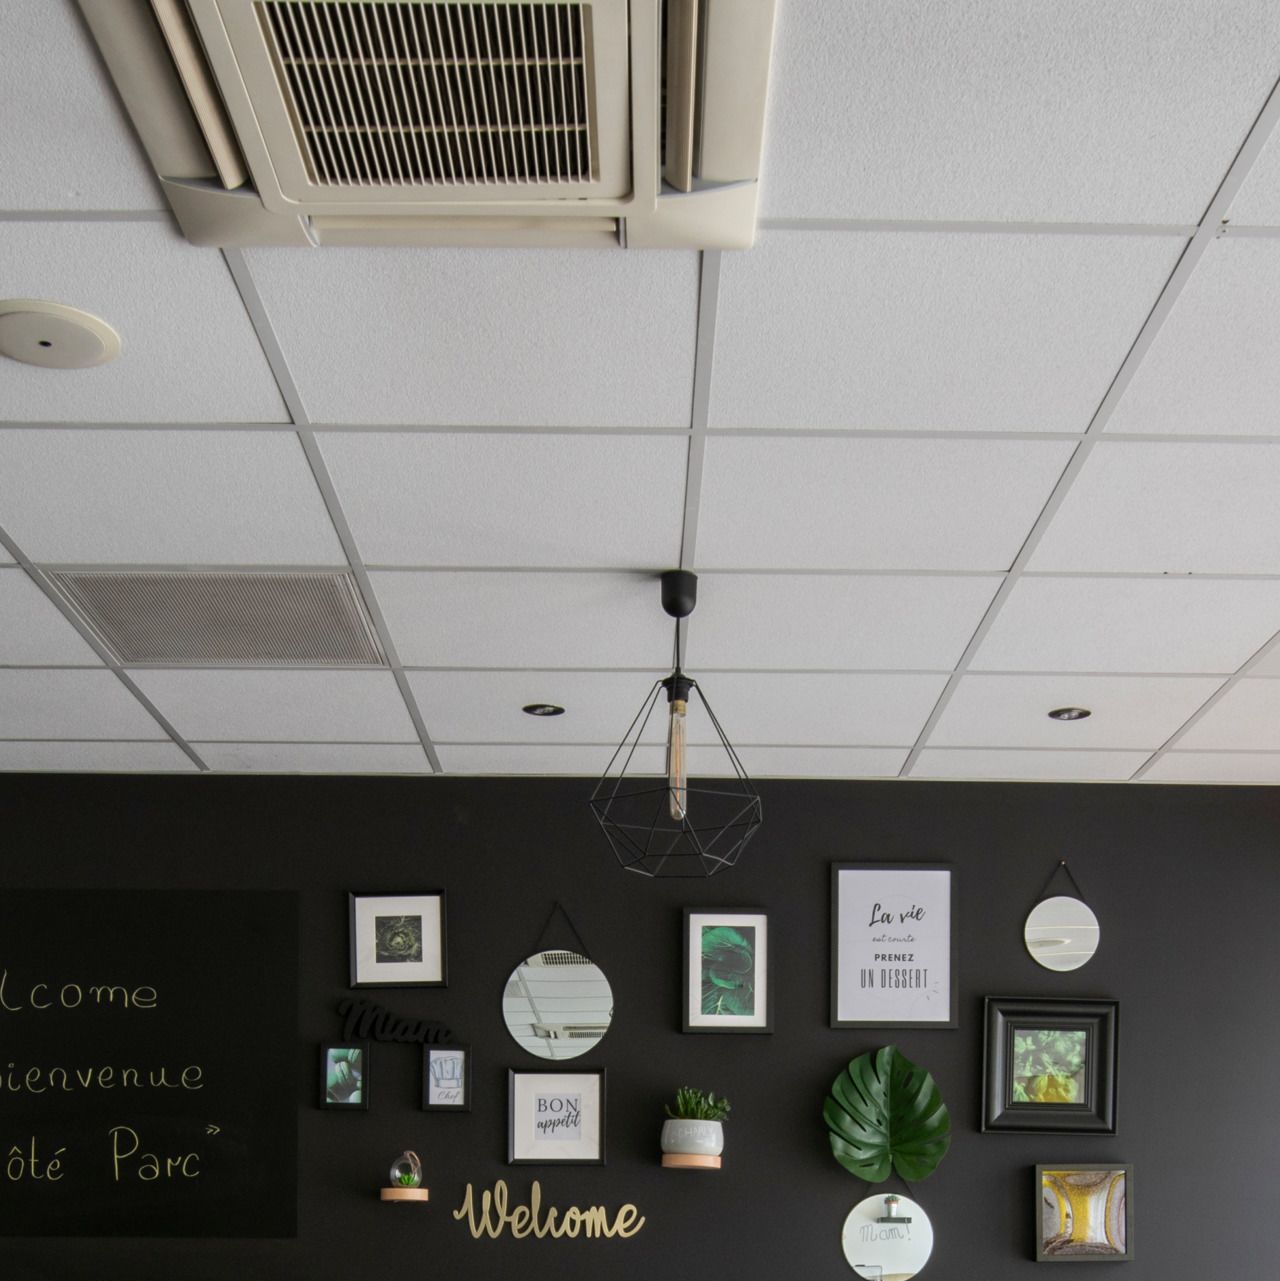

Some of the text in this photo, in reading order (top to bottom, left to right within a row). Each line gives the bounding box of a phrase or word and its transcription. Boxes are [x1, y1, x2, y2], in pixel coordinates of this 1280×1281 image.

[869, 903, 926, 927] La vie
[874, 953, 915, 962] PRENEZ
[860, 968, 928, 988] UN DESSERT
[437, 1089, 460, 1104] Chef
[537, 1098, 579, 1114] BON
[537, 1110, 581, 1137] appétit
[453, 1179, 646, 1239] Welcome
